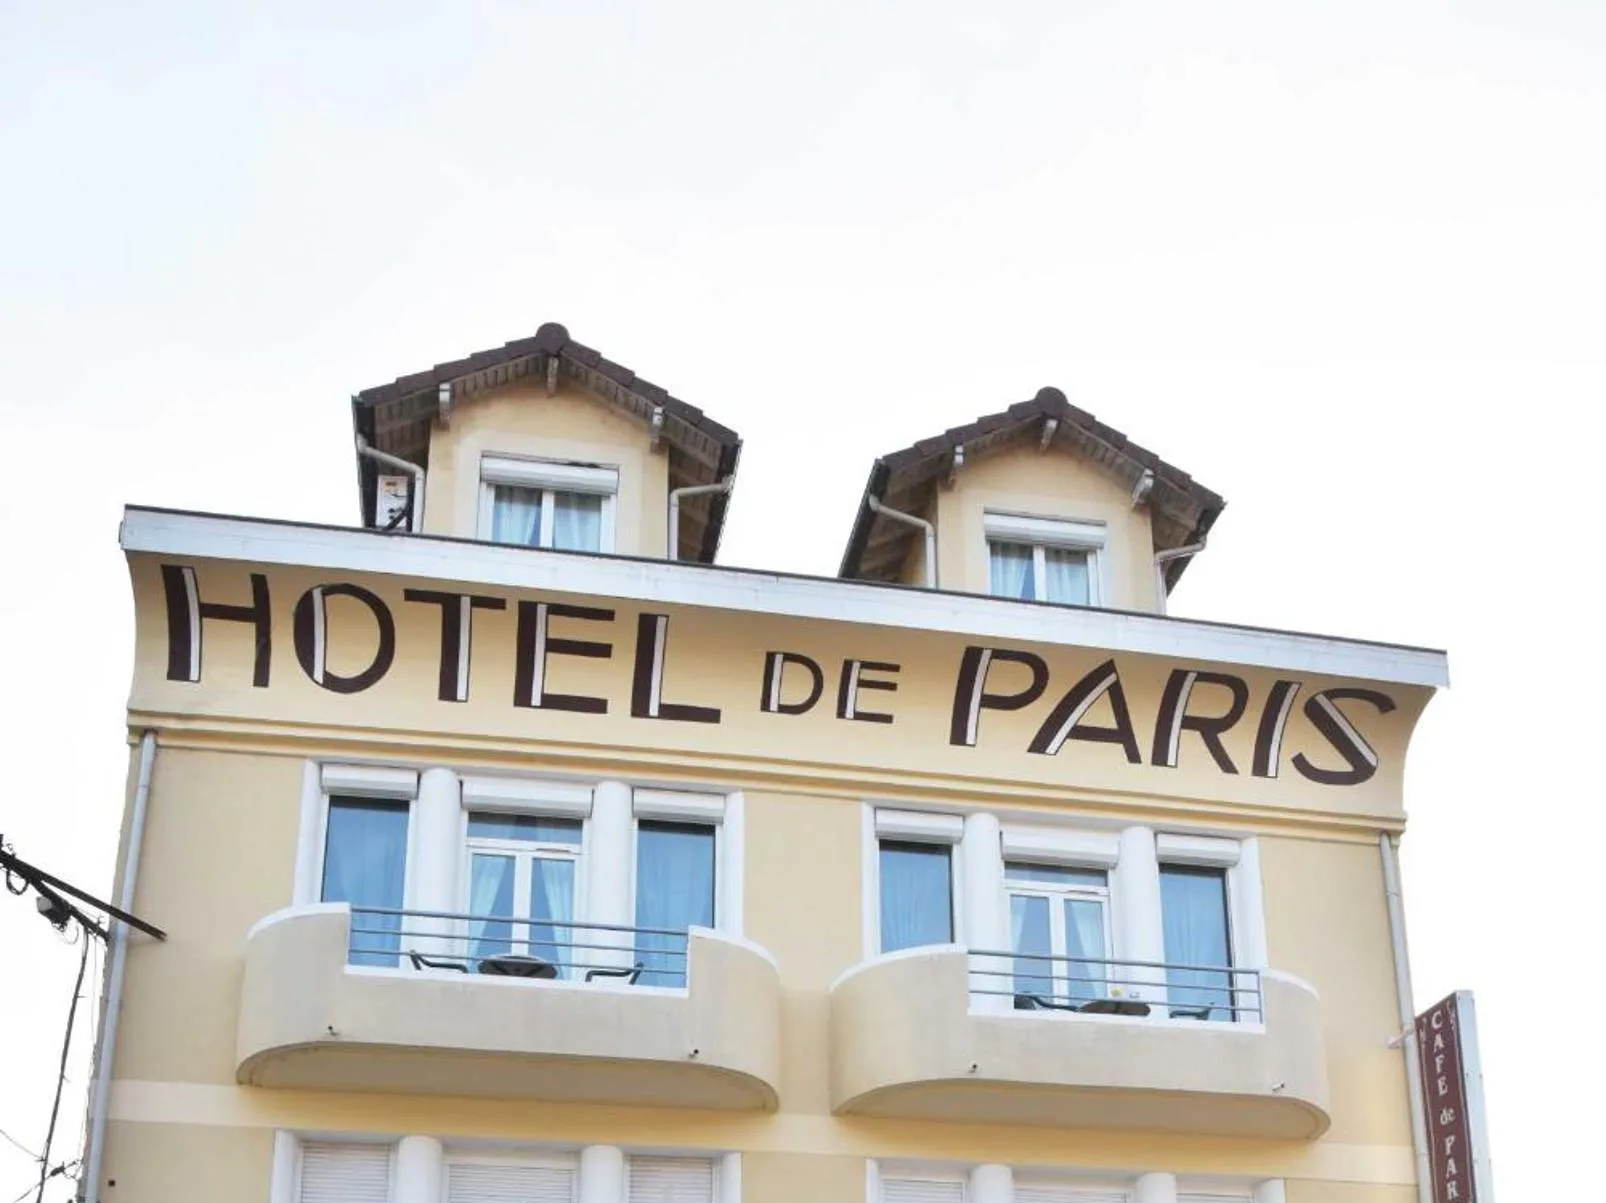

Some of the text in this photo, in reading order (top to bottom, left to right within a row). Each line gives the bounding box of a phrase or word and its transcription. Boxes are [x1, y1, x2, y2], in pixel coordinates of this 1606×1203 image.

[160, 564, 1397, 786] HOTEL DE PARIS
